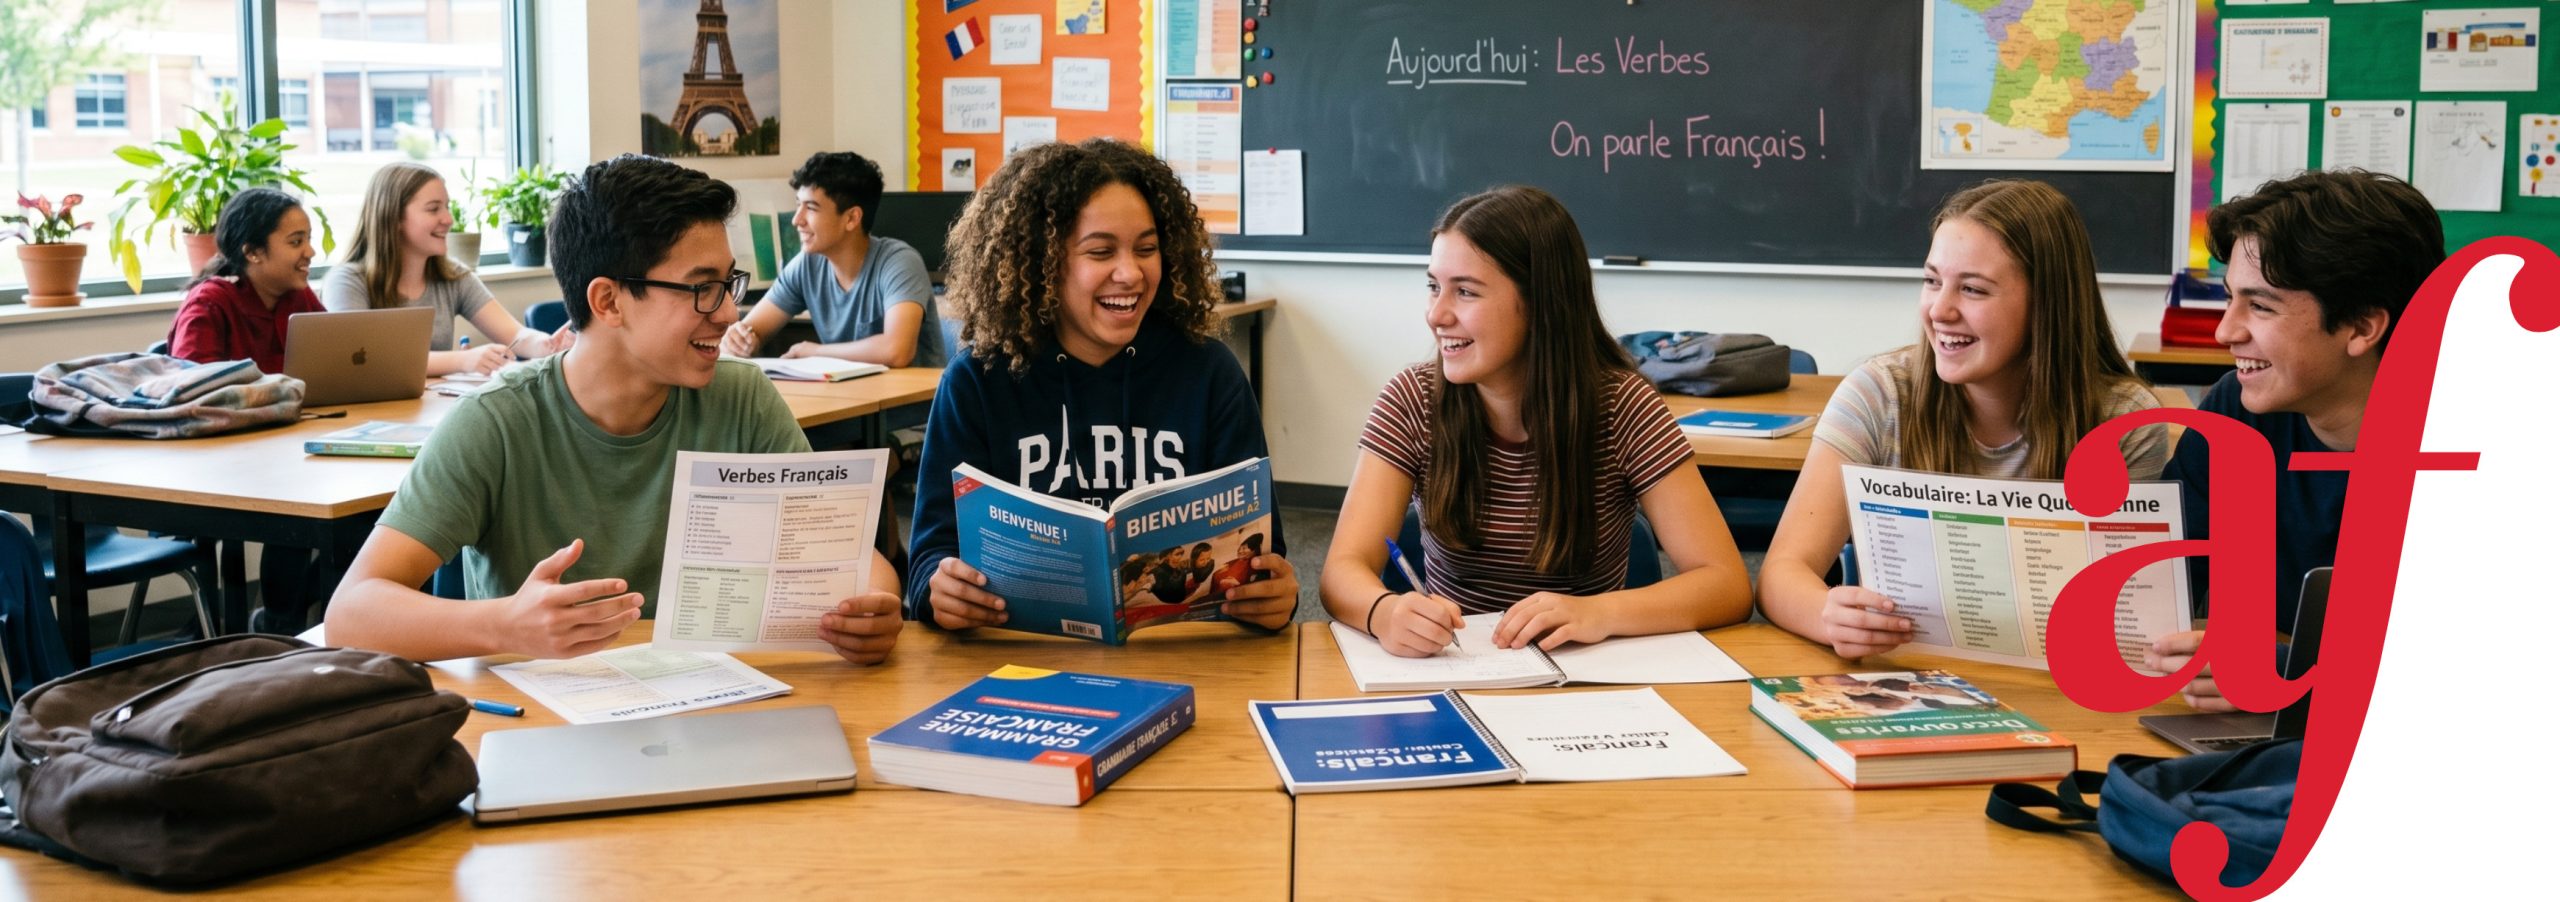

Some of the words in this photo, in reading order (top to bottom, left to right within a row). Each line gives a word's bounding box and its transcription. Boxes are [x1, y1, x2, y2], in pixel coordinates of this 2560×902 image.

[1556, 36, 1606, 75] Les
[1614, 35, 1711, 76] Verbes
[1550, 120, 1591, 158] On
[1602, 119, 1672, 173] parle
[1686, 115, 1807, 168] Français
[1017, 403, 1186, 494] PARIS
[718, 467, 776, 484] Verbes
[780, 464, 849, 485] Français
[1859, 477, 1971, 505] Vocabulaire:
[1976, 489, 1998, 507] La
[2001, 491, 2033, 509] Vie
[1126, 484, 1246, 539] BIENVENUE
[1208, 509, 1245, 528] Niveau
[1246, 501, 1261, 515] A2
[919, 719, 1082, 749] GRAMMAIRE
